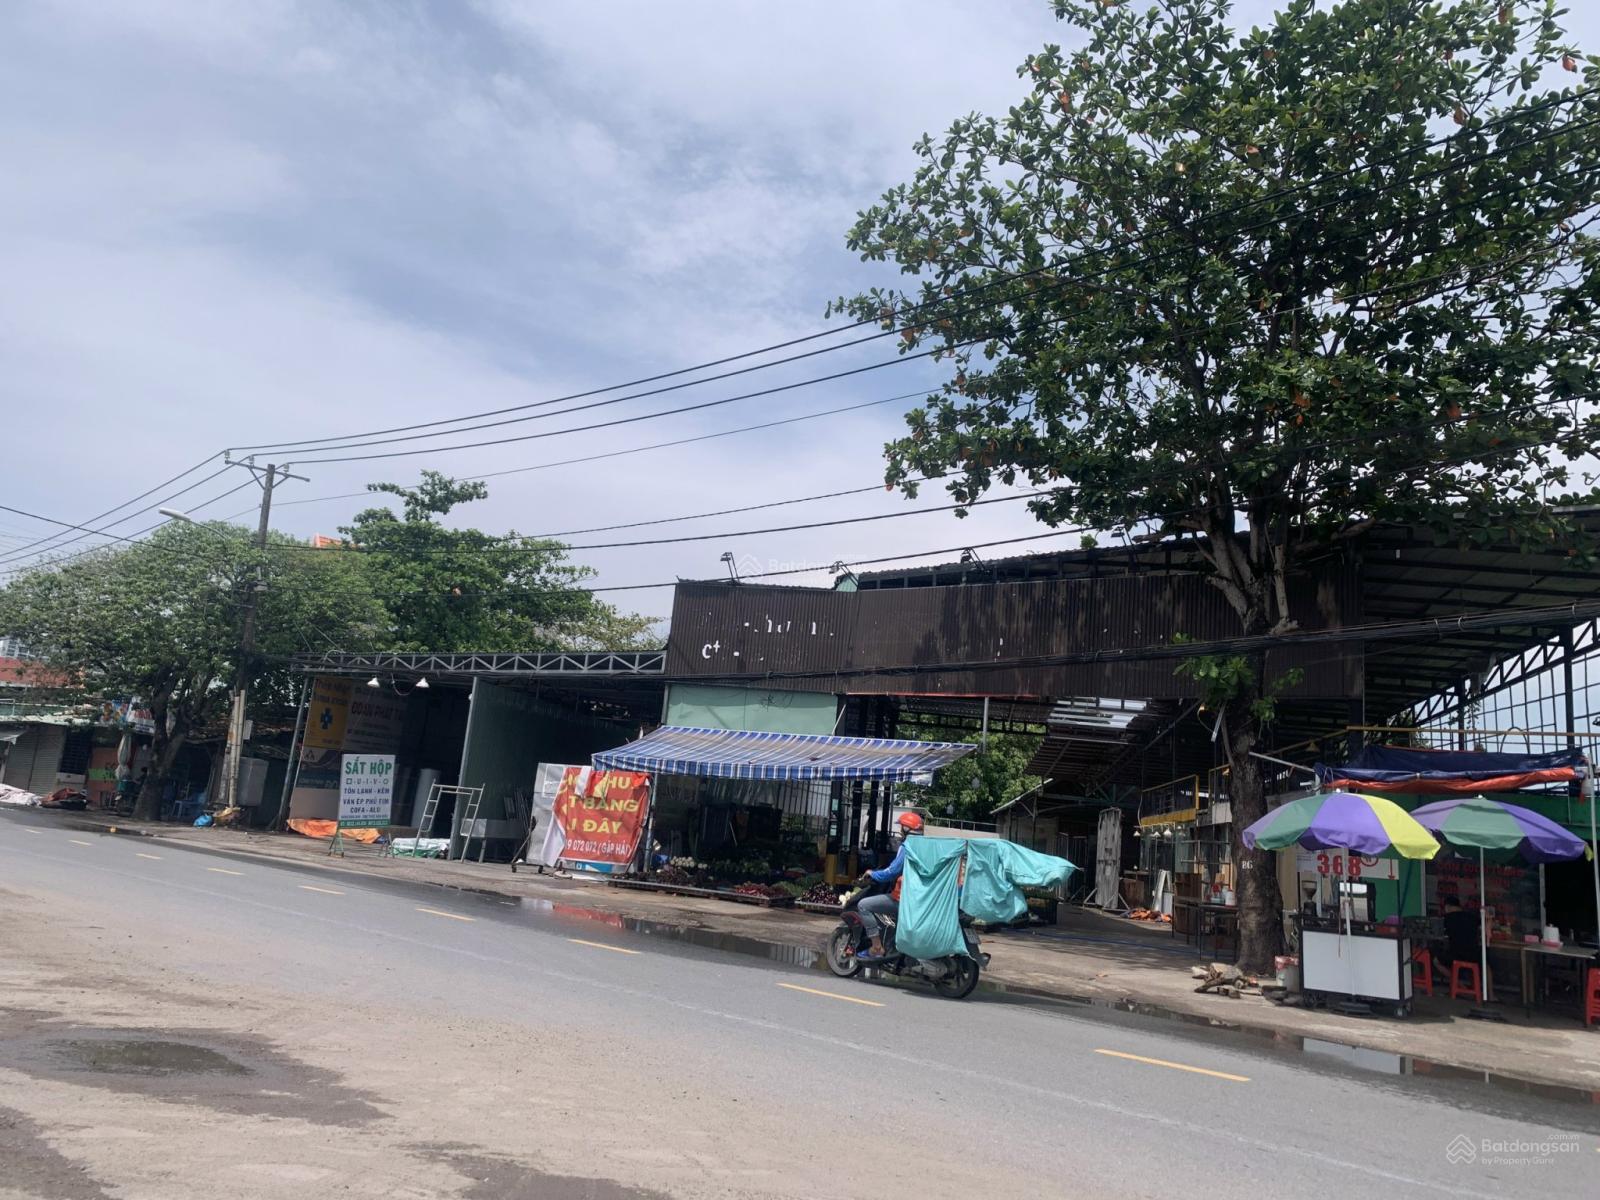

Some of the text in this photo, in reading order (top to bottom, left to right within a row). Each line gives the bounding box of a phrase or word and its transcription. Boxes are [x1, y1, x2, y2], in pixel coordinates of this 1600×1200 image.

[345, 756, 392, 777] SẮT HỘP
[582, 817, 623, 833] ĐÂY
[572, 840, 585, 852] 072
[585, 841, 597, 853] 072
[1317, 853, 1361, 877] 368
